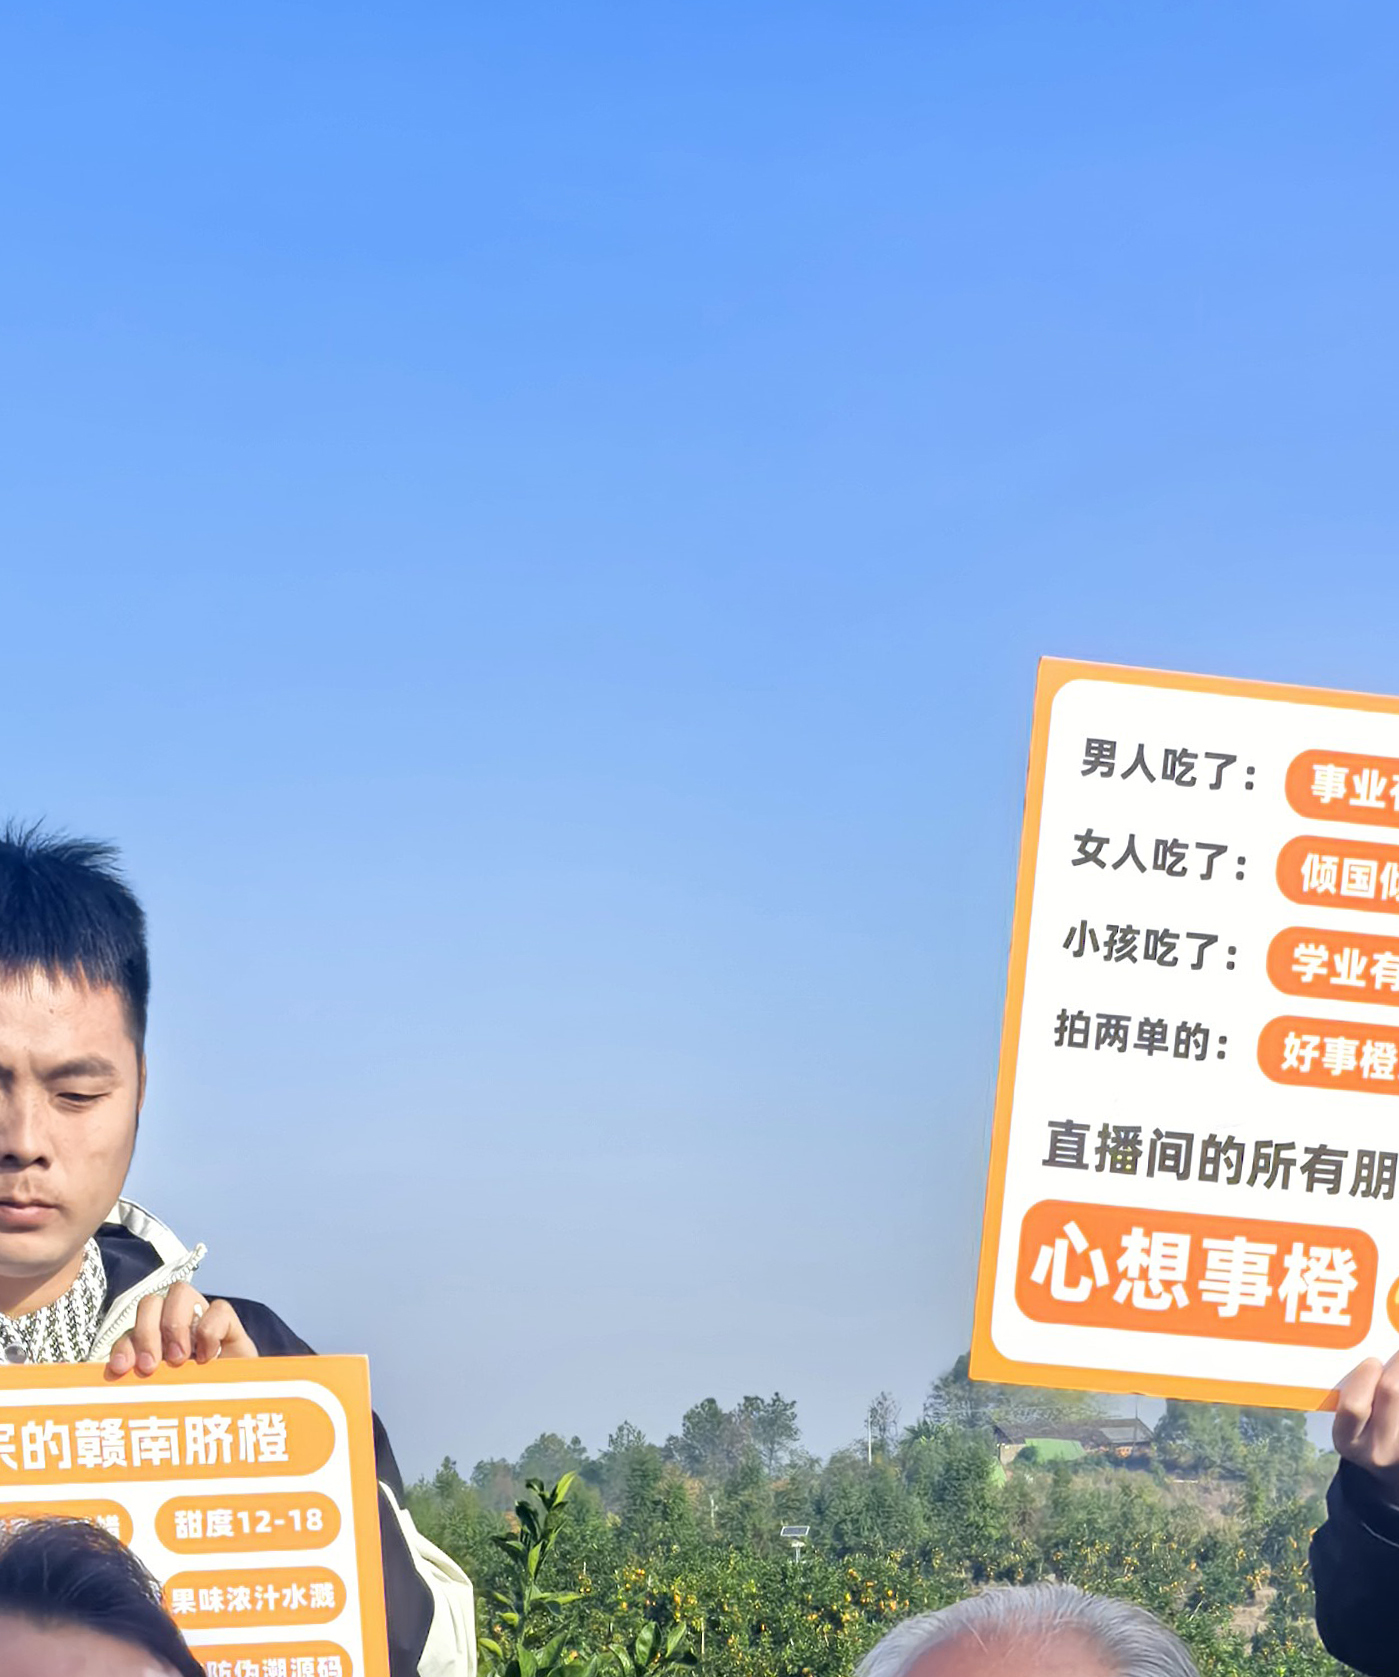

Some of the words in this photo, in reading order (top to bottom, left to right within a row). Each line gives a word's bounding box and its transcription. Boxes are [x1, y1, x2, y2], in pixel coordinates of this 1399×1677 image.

[1080, 737, 1257, 792] 男人吃了：
[1071, 829, 1247, 882] 女人吃了：
[1062, 919, 1238, 972] 小孩吃了：
[1053, 1009, 1229, 1062] 拍两单的：
[1031, 1221, 1360, 1328] 心想事橙
[174, 1508, 324, 1539] 甜度12-18
[171, 1582, 336, 1615] 果味浓汁水溅
